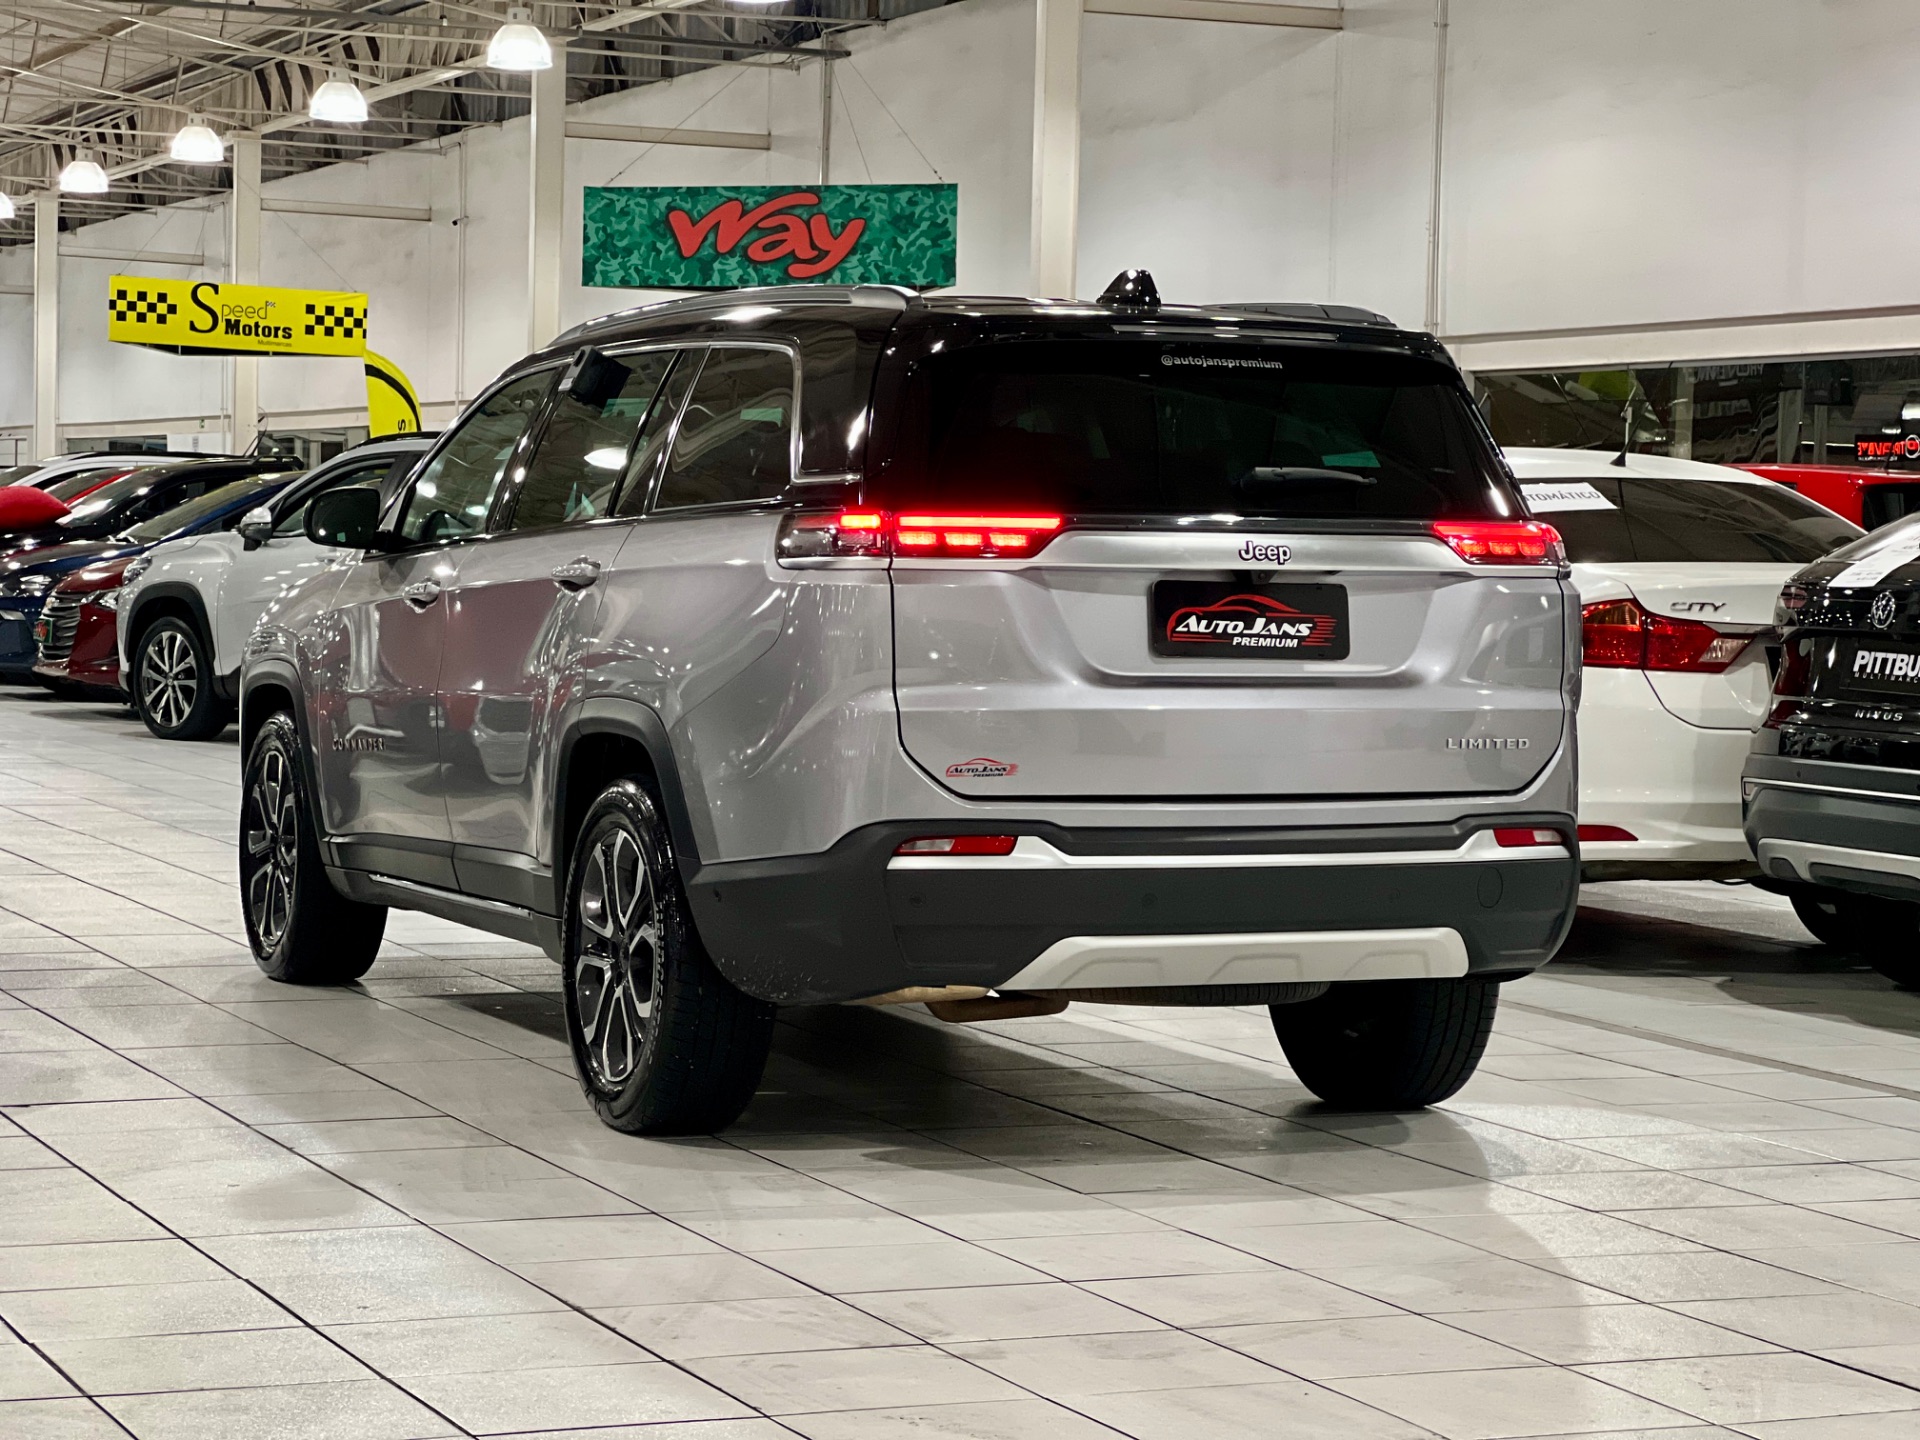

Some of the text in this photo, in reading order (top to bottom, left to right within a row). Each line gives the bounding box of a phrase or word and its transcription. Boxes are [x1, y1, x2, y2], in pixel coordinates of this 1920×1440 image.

[667, 192, 866, 278] Way
[190, 282, 268, 333] Speed
[224, 318, 292, 339] Motors
[1160, 354, 1283, 369] @autojanspremium
[1239, 541, 1291, 564] Jeep
[1670, 602, 1727, 612] CITY
[1232, 636, 1299, 648] PREMIUM
[1852, 650, 1920, 678] PITTBU
[1446, 738, 1529, 750] LIMITED
